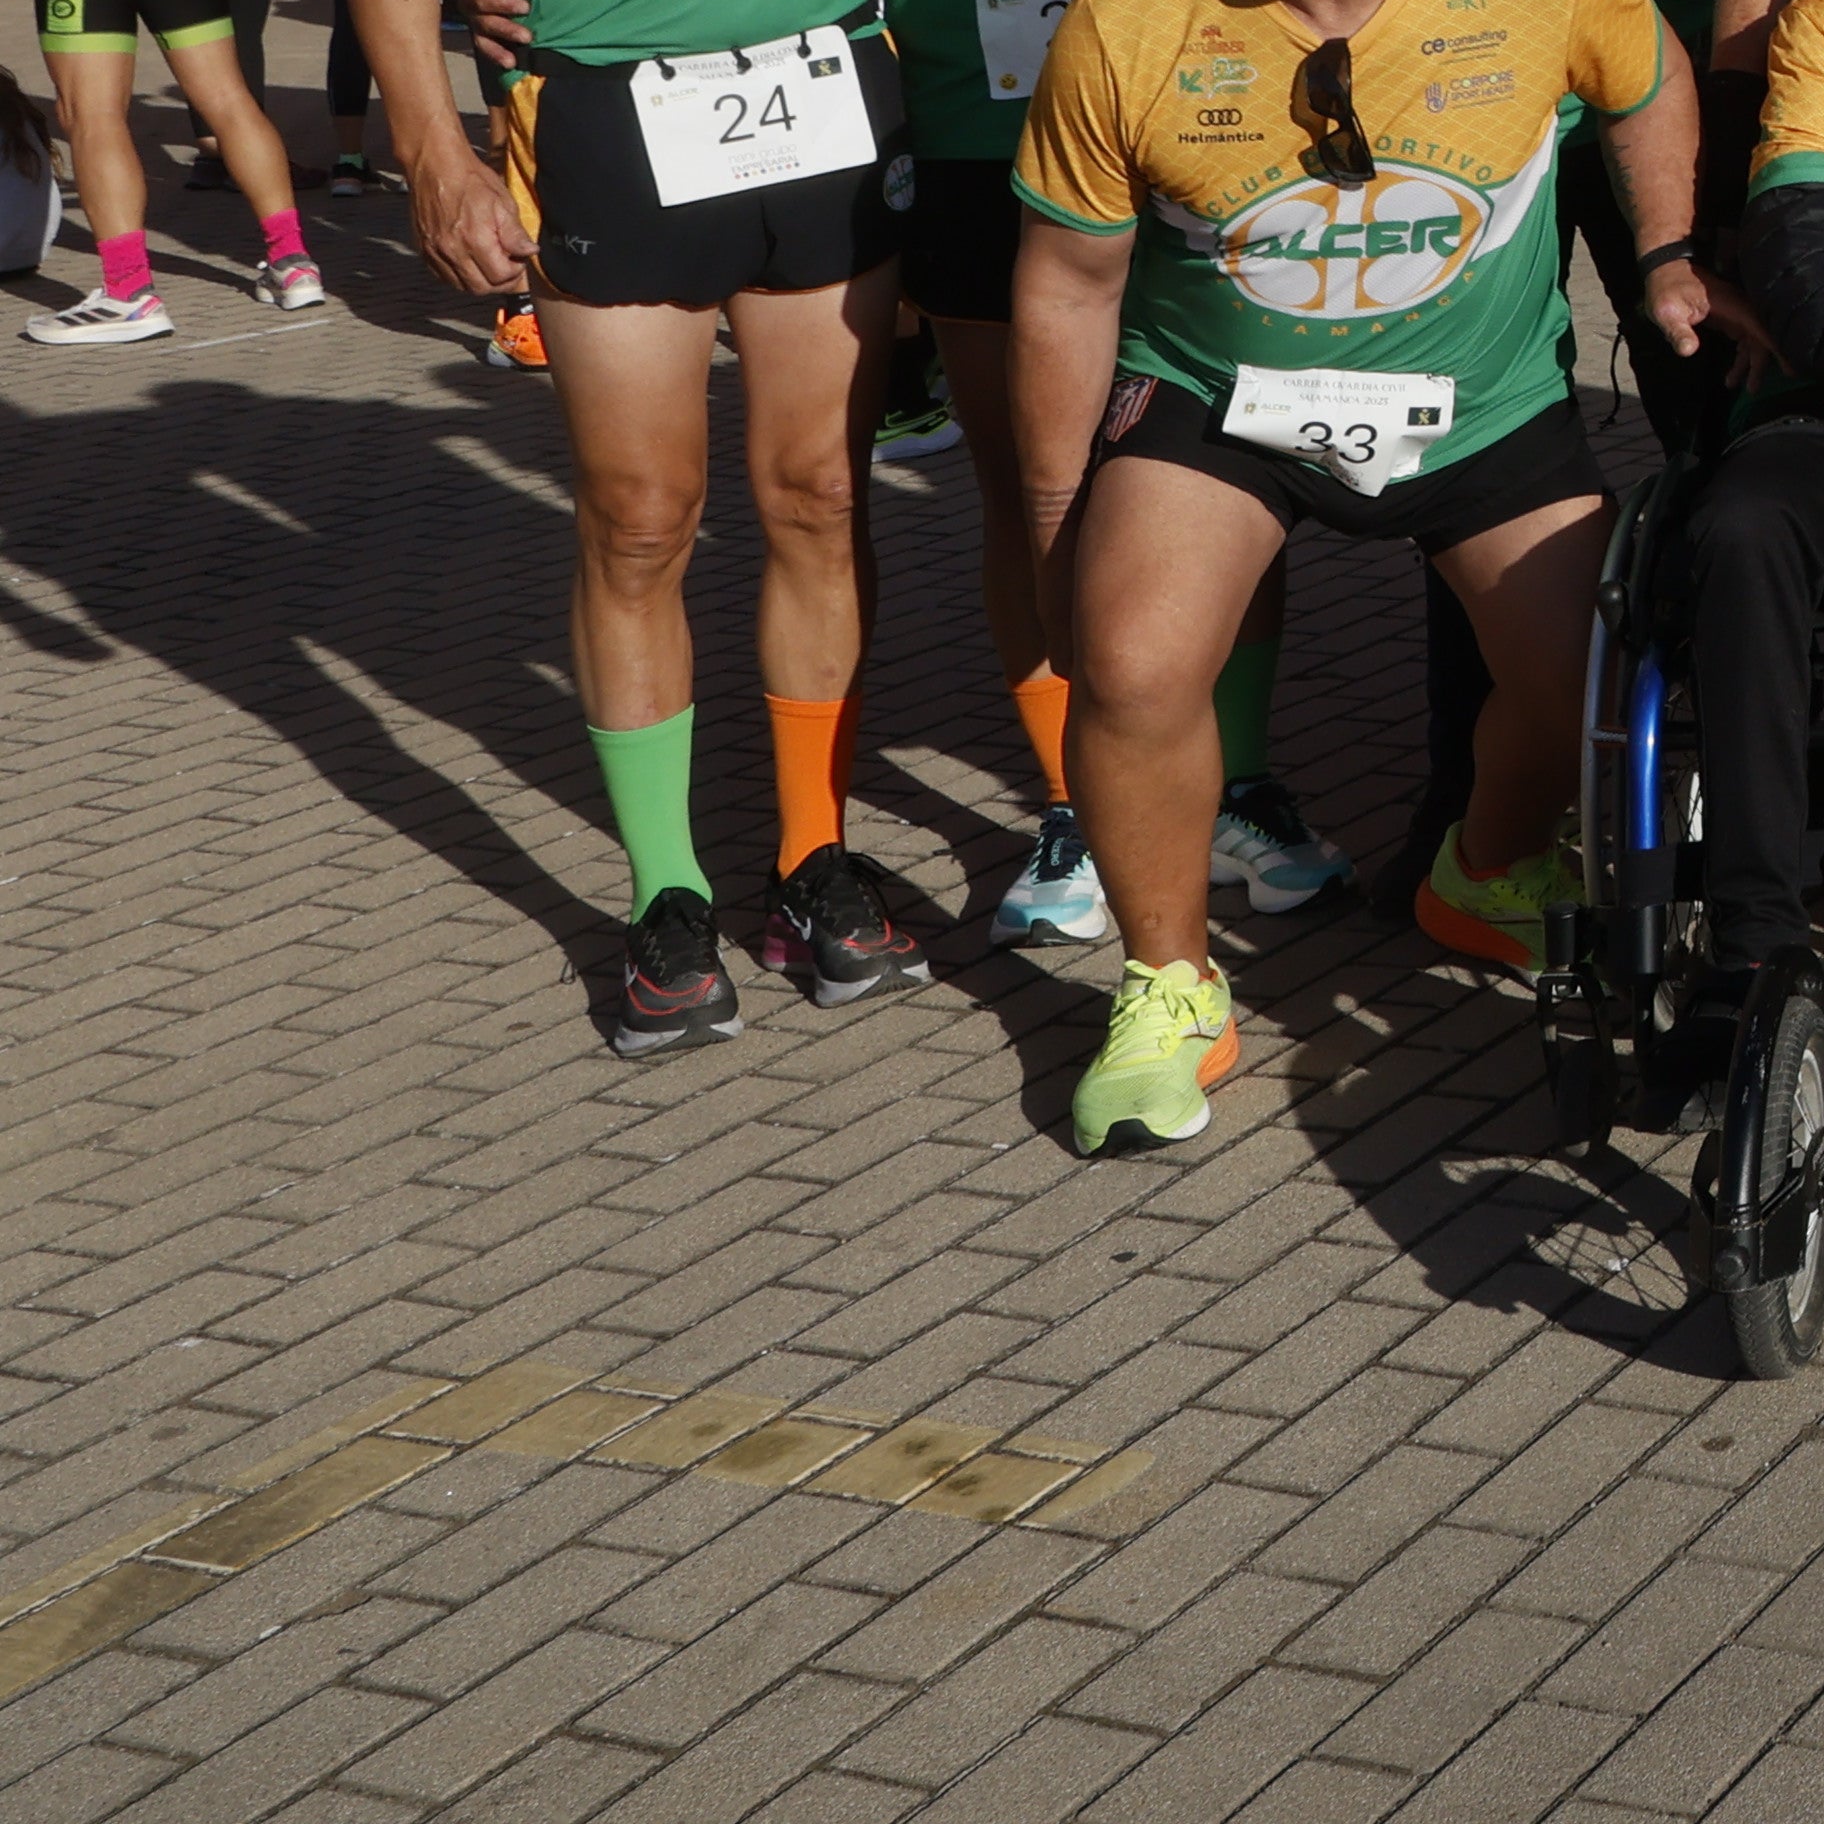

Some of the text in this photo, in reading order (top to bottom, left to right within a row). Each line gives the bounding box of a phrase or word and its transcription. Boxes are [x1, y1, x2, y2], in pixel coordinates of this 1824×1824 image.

[1447, 29, 1507, 52] consulting
[1450, 69, 1514, 89] CORPORE
[714, 83, 797, 145] 24
[1178, 130, 1265, 144] Helmántica
[1206, 165, 1283, 219] CLUB
[1239, 216, 1463, 261] ALCER
[1294, 421, 1378, 464] 33
